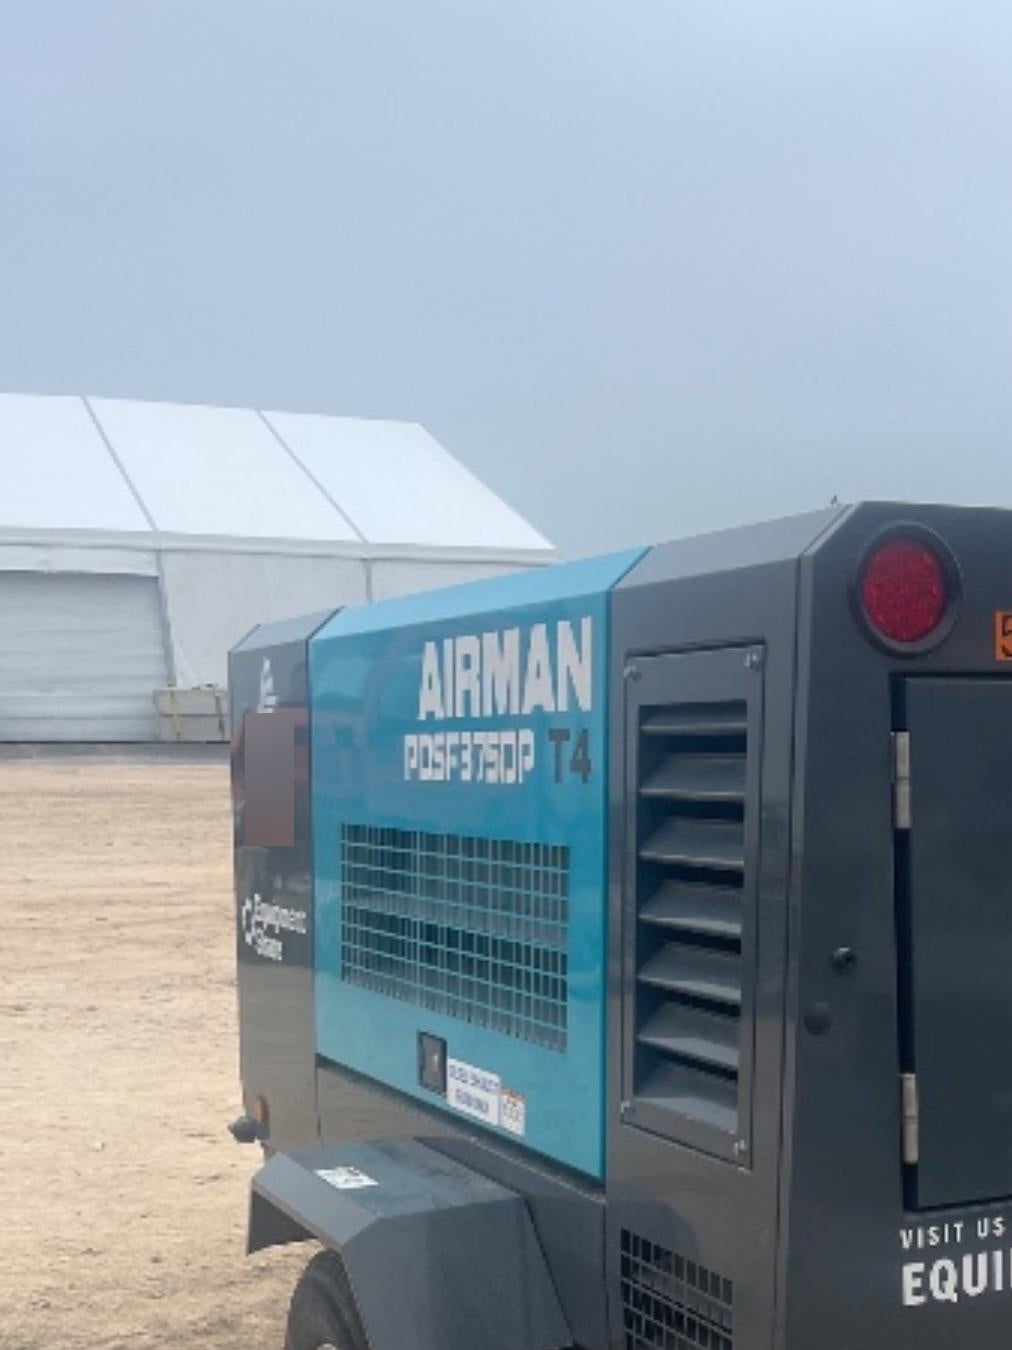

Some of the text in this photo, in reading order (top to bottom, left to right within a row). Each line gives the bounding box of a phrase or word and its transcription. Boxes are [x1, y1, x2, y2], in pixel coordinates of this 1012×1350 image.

[418, 614, 592, 721] AIRMAN
[548, 728, 592, 784] T4
[900, 1222, 964, 1250] VISIT
[977, 1215, 1006, 1239] US
